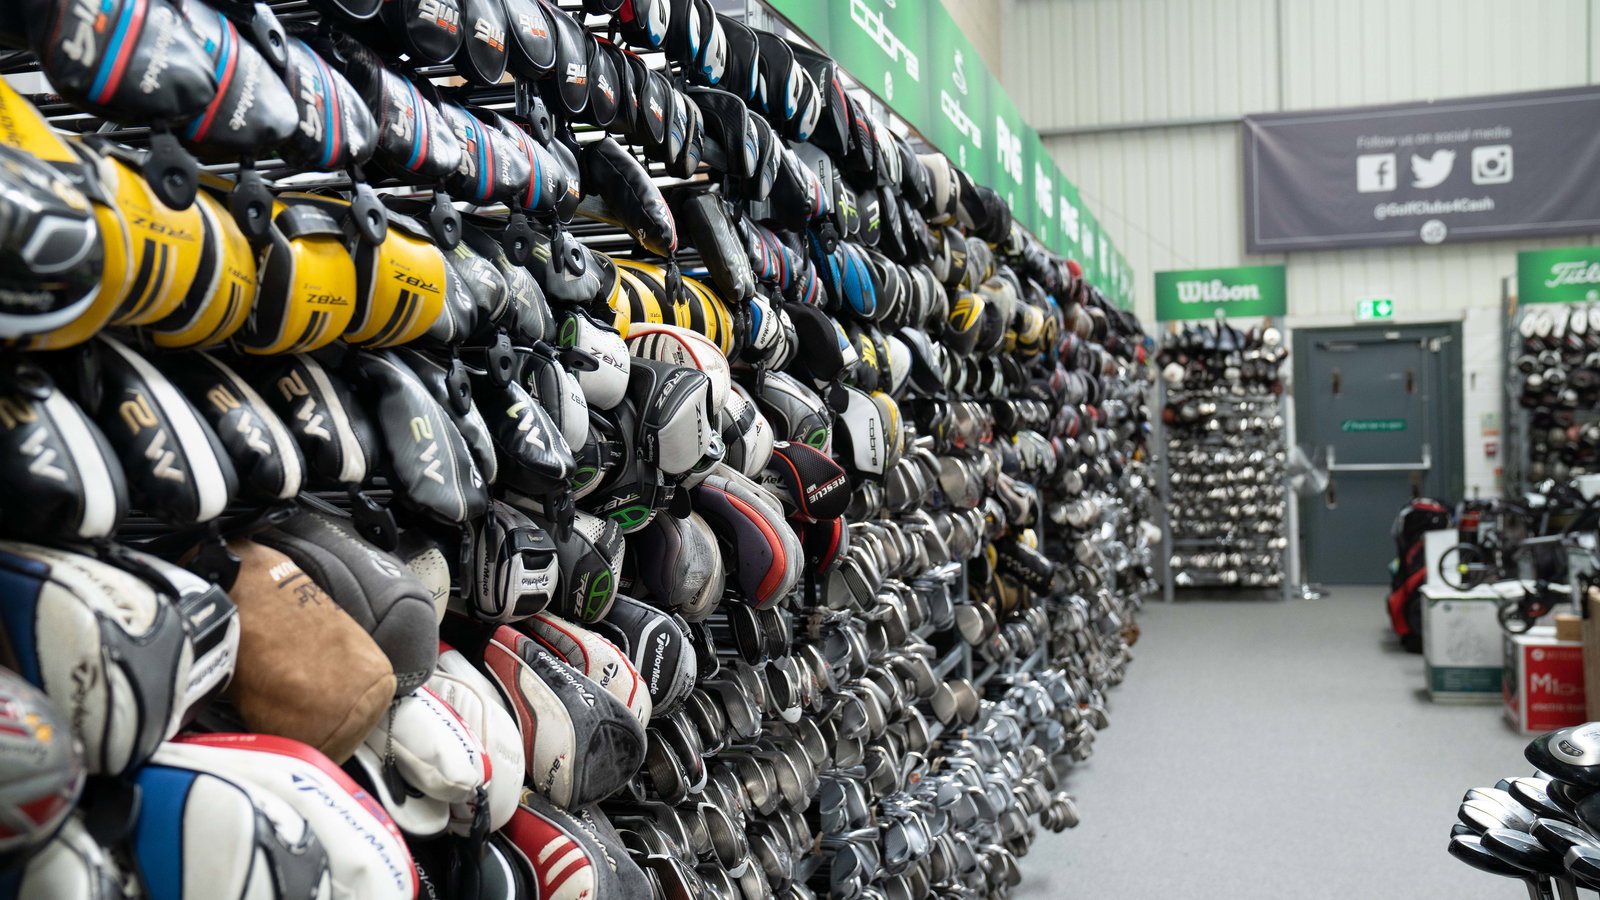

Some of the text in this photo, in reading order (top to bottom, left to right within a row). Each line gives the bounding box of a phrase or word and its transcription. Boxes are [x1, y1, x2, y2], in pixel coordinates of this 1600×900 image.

[474, 17, 505, 52] M6
[565, 62, 587, 84] M6
[393, 269, 441, 295] RBZ
[1176, 278, 1261, 304] Wilson
[306, 292, 349, 306] RBZ
[590, 346, 629, 375] RBZ
[867, 417, 879, 467] cobra
[809, 474, 847, 504] RESCUE
[572, 570, 591, 618] RBZ
[538, 651, 596, 708] TaylorMade
[650, 631, 671, 696] TaylorMade
[291, 773, 405, 892] TaylorMade
